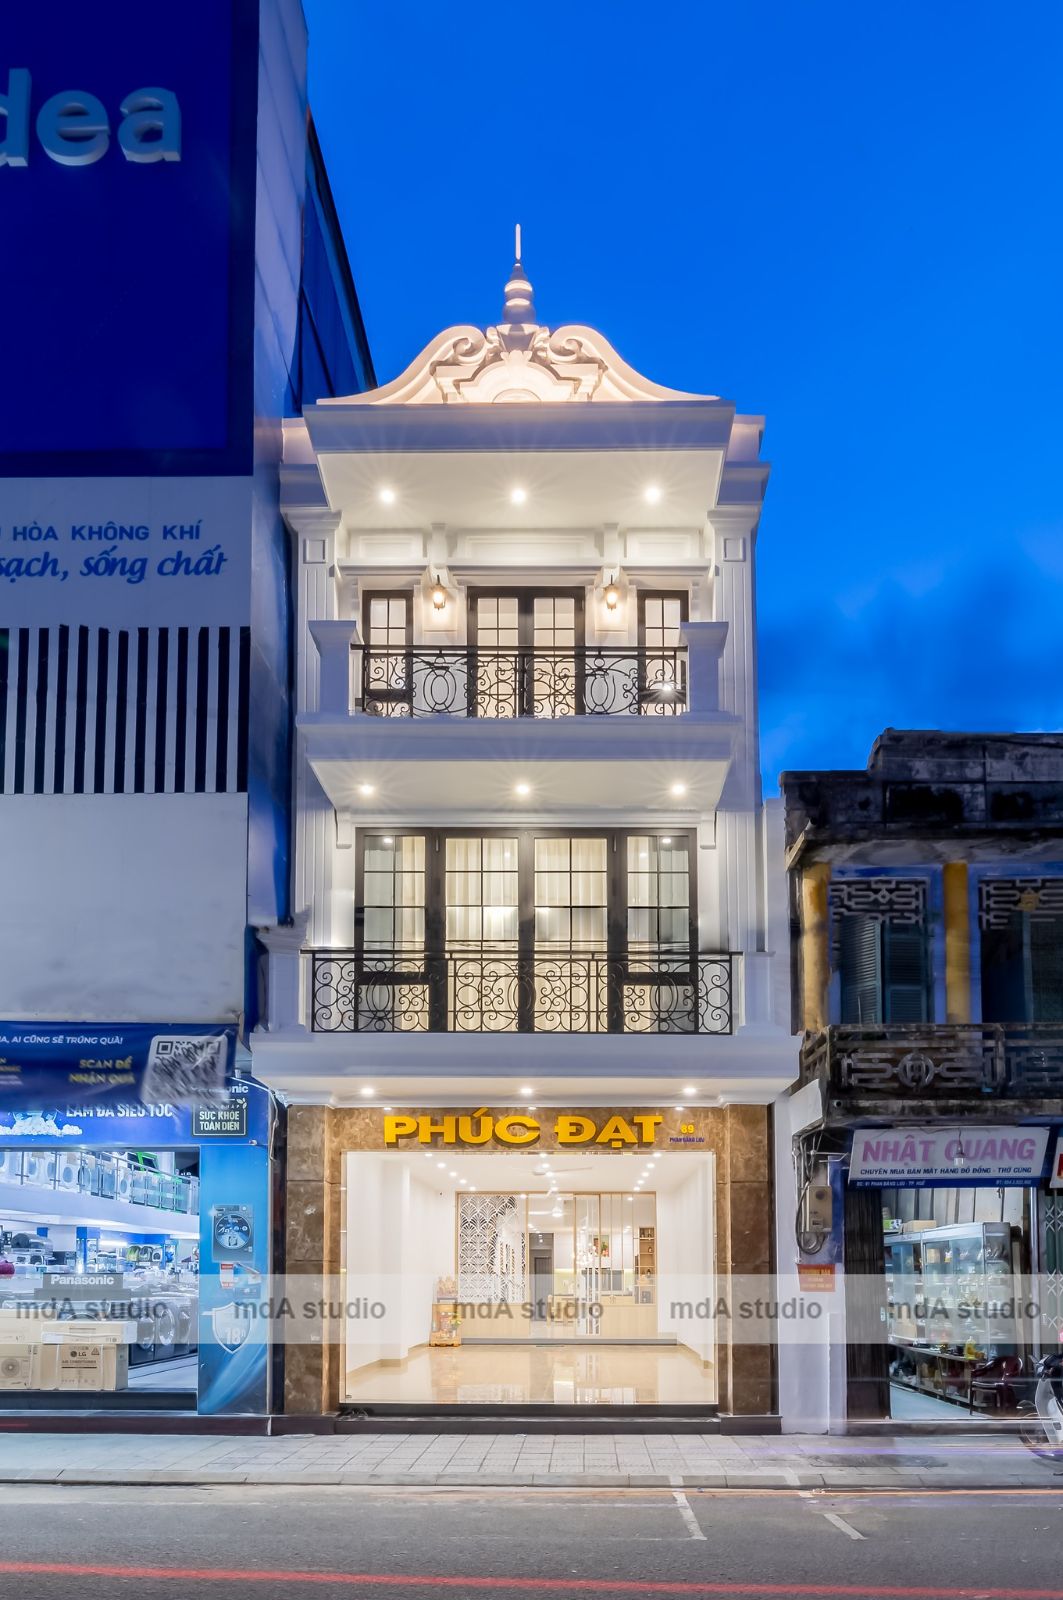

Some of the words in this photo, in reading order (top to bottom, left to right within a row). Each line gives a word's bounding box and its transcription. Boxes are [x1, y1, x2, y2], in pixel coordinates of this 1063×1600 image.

[12, 521, 59, 541] HÒA
[71, 521, 150, 541] KHÔNG
[163, 519, 203, 540] KHÍ
[0, 551, 69, 582] sạch,
[80, 545, 148, 584] sống
[157, 544, 228, 577] chất
[23, 1034, 50, 1044] CŨNG
[52, 1035, 63, 1044] SẼ
[66, 1035, 98, 1045] TRÚNG
[100, 1036, 123, 1045] QUÀ!
[79, 1059, 113, 1069] SCAN
[383, 1107, 541, 1145] PHÚC
[554, 1115, 663, 1148] ĐẠT
[862, 1134, 936, 1166] NHẬT
[943, 1137, 1036, 1162] QUANG
[50, 1274, 114, 1286] Panasonic
